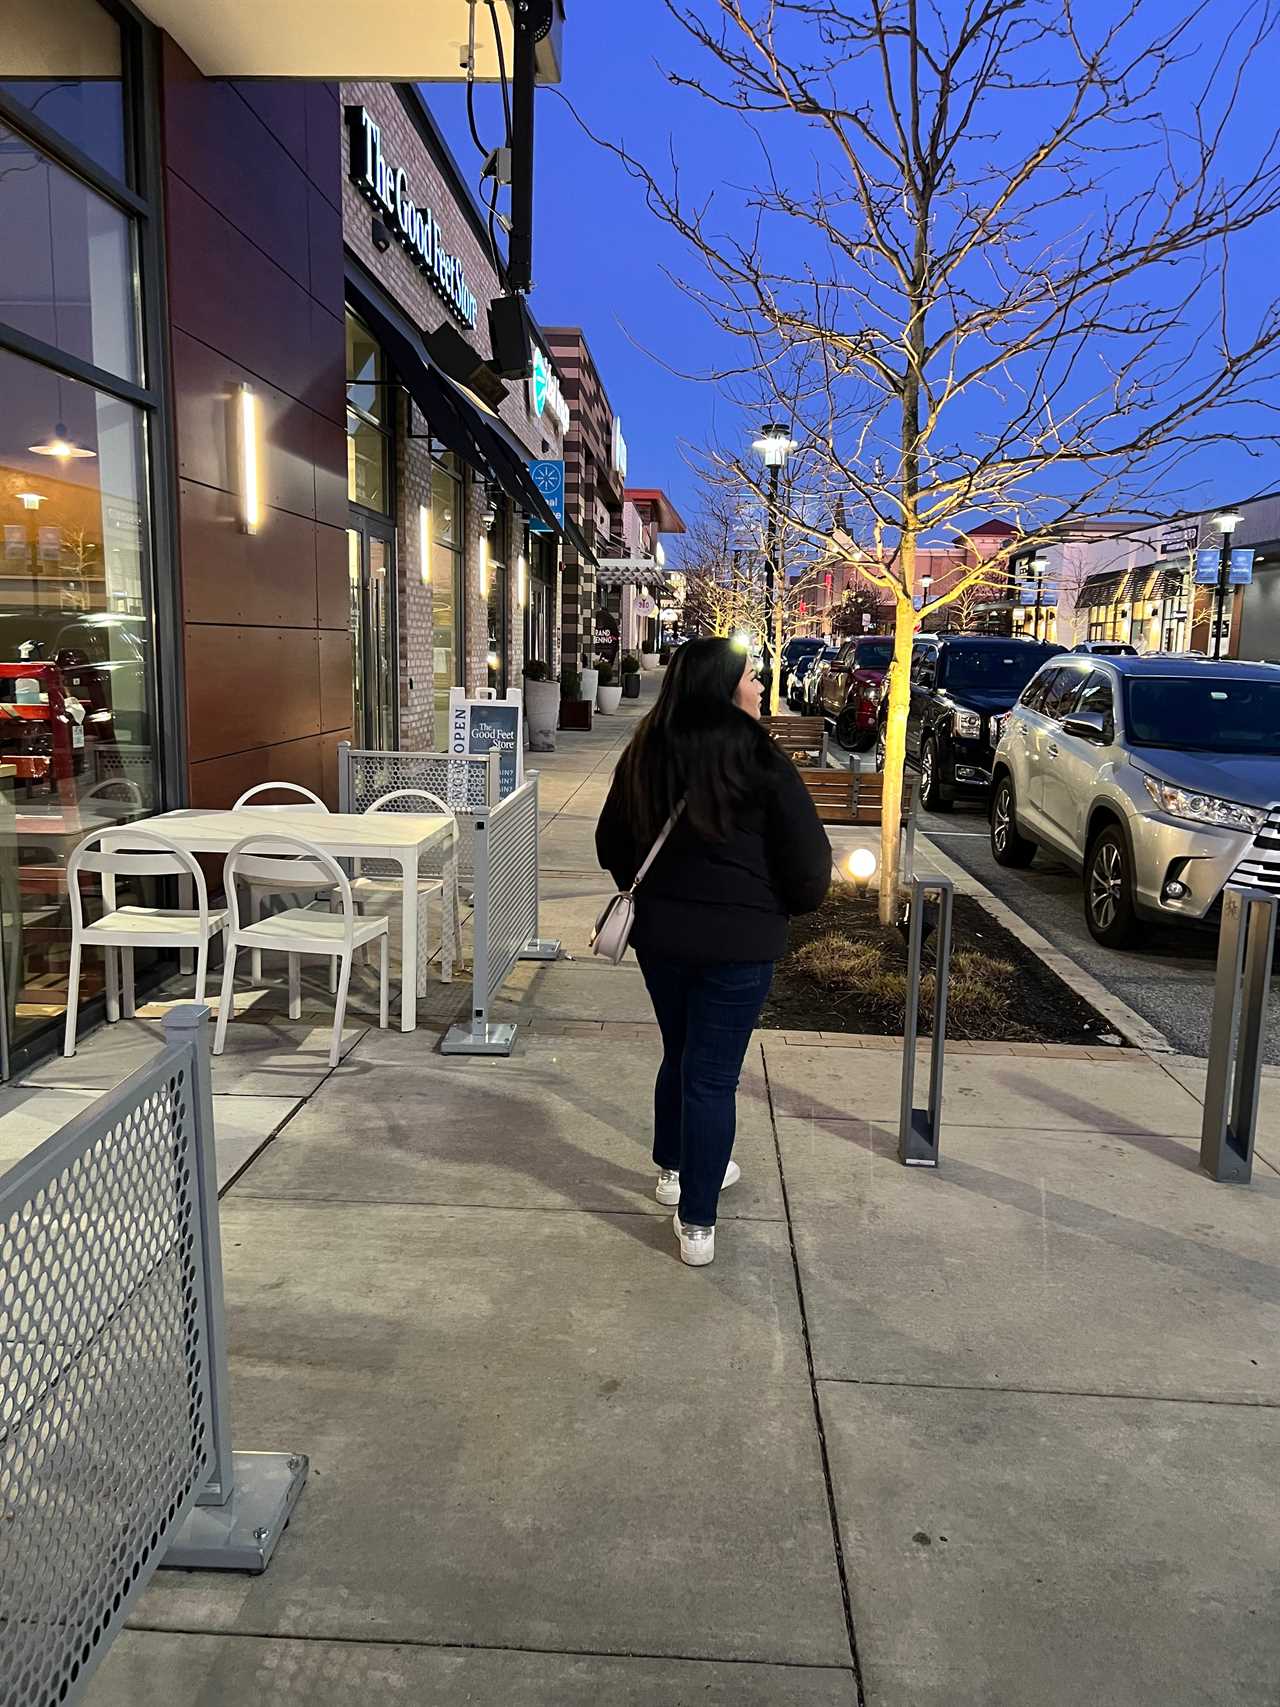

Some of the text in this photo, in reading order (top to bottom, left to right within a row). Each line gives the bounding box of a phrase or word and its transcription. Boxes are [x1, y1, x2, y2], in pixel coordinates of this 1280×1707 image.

[362, 107, 479, 331] The Good Feet Store
[453, 709, 467, 754] OPEN
[479, 722, 492, 731] The
[471, 729, 514, 740] Good Feet
[492, 739, 515, 750] Store
